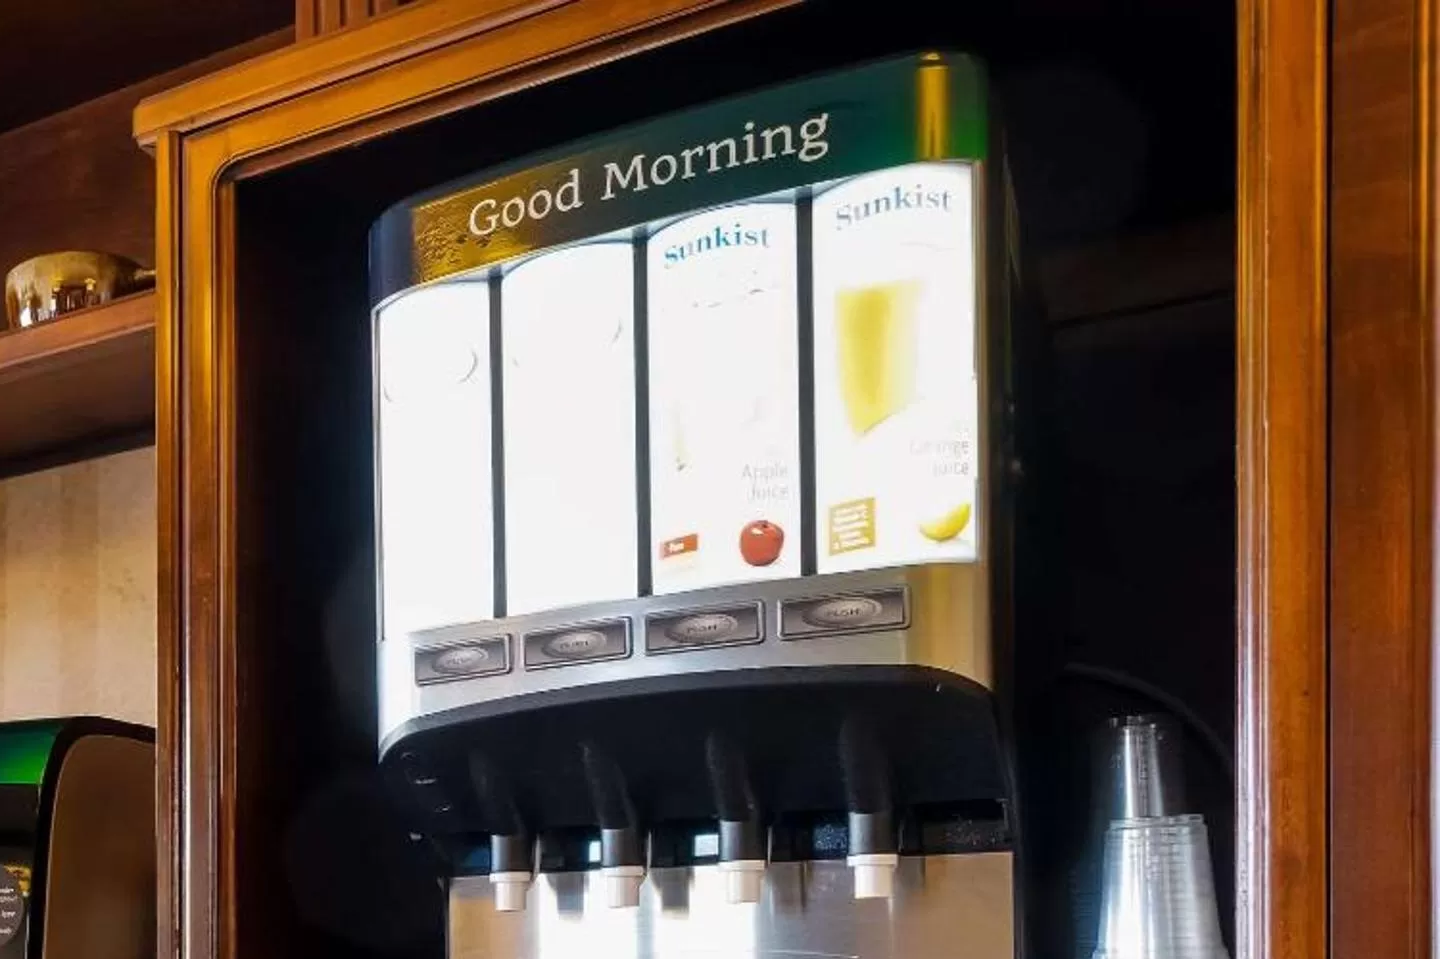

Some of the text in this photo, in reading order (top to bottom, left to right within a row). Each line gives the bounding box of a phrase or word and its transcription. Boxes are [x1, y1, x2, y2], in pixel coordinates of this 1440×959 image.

[468, 112, 829, 236] Good Morning
[836, 184, 953, 231] Sunkist
[664, 223, 771, 269] Sunkist
